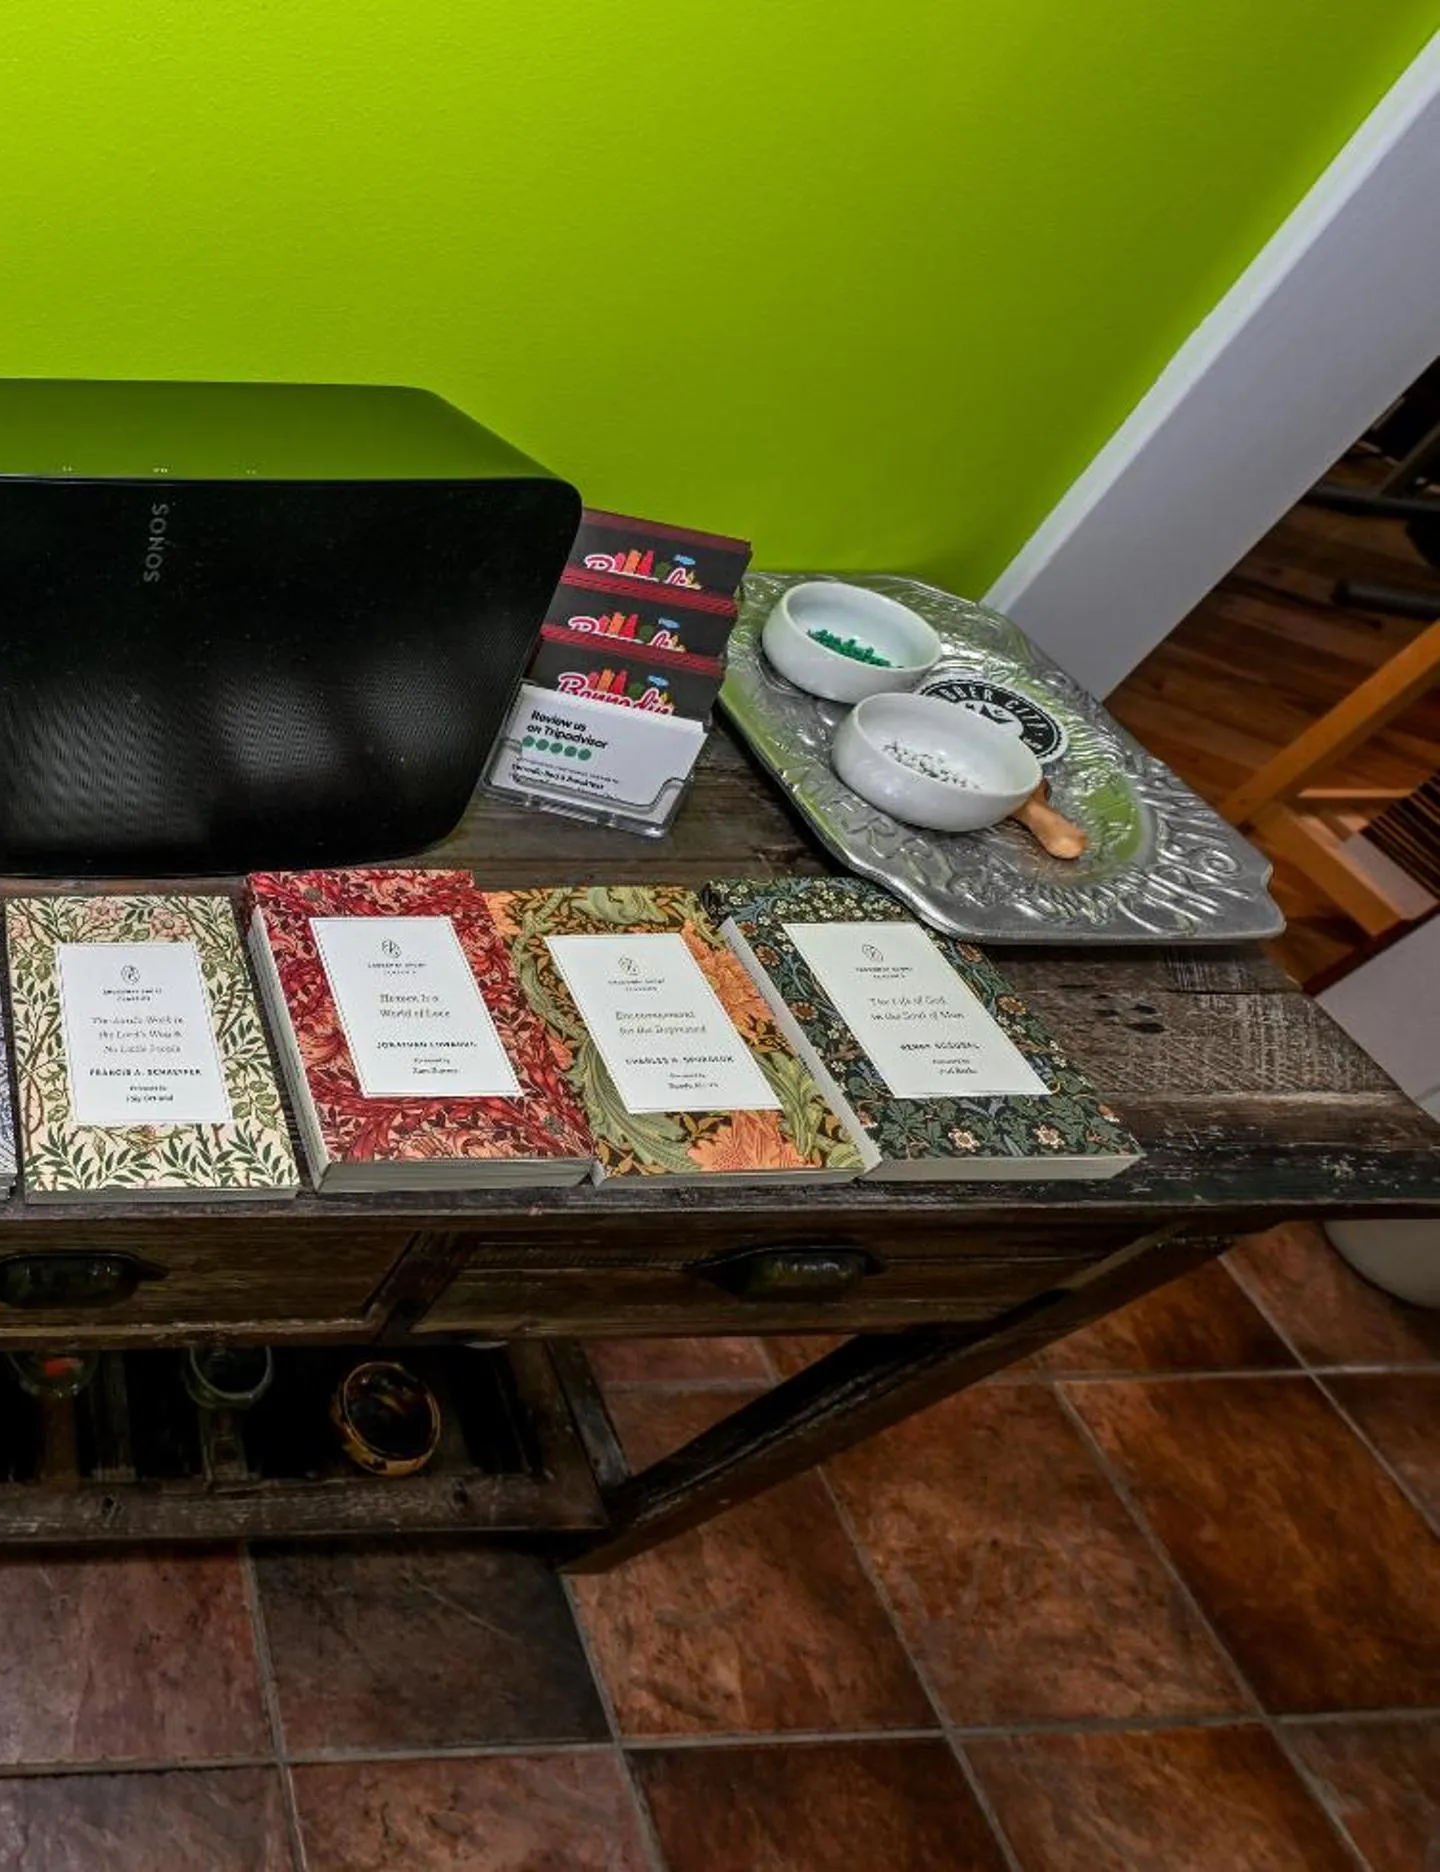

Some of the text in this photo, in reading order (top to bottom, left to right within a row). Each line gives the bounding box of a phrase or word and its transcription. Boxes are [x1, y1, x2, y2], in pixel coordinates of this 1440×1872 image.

[143, 502, 169, 582] SONOS
[531, 710, 586, 731] Review us
[527, 725, 608, 748] on Tripadvisor
[379, 1010, 411, 1018] World
[413, 1010, 424, 1019] of
